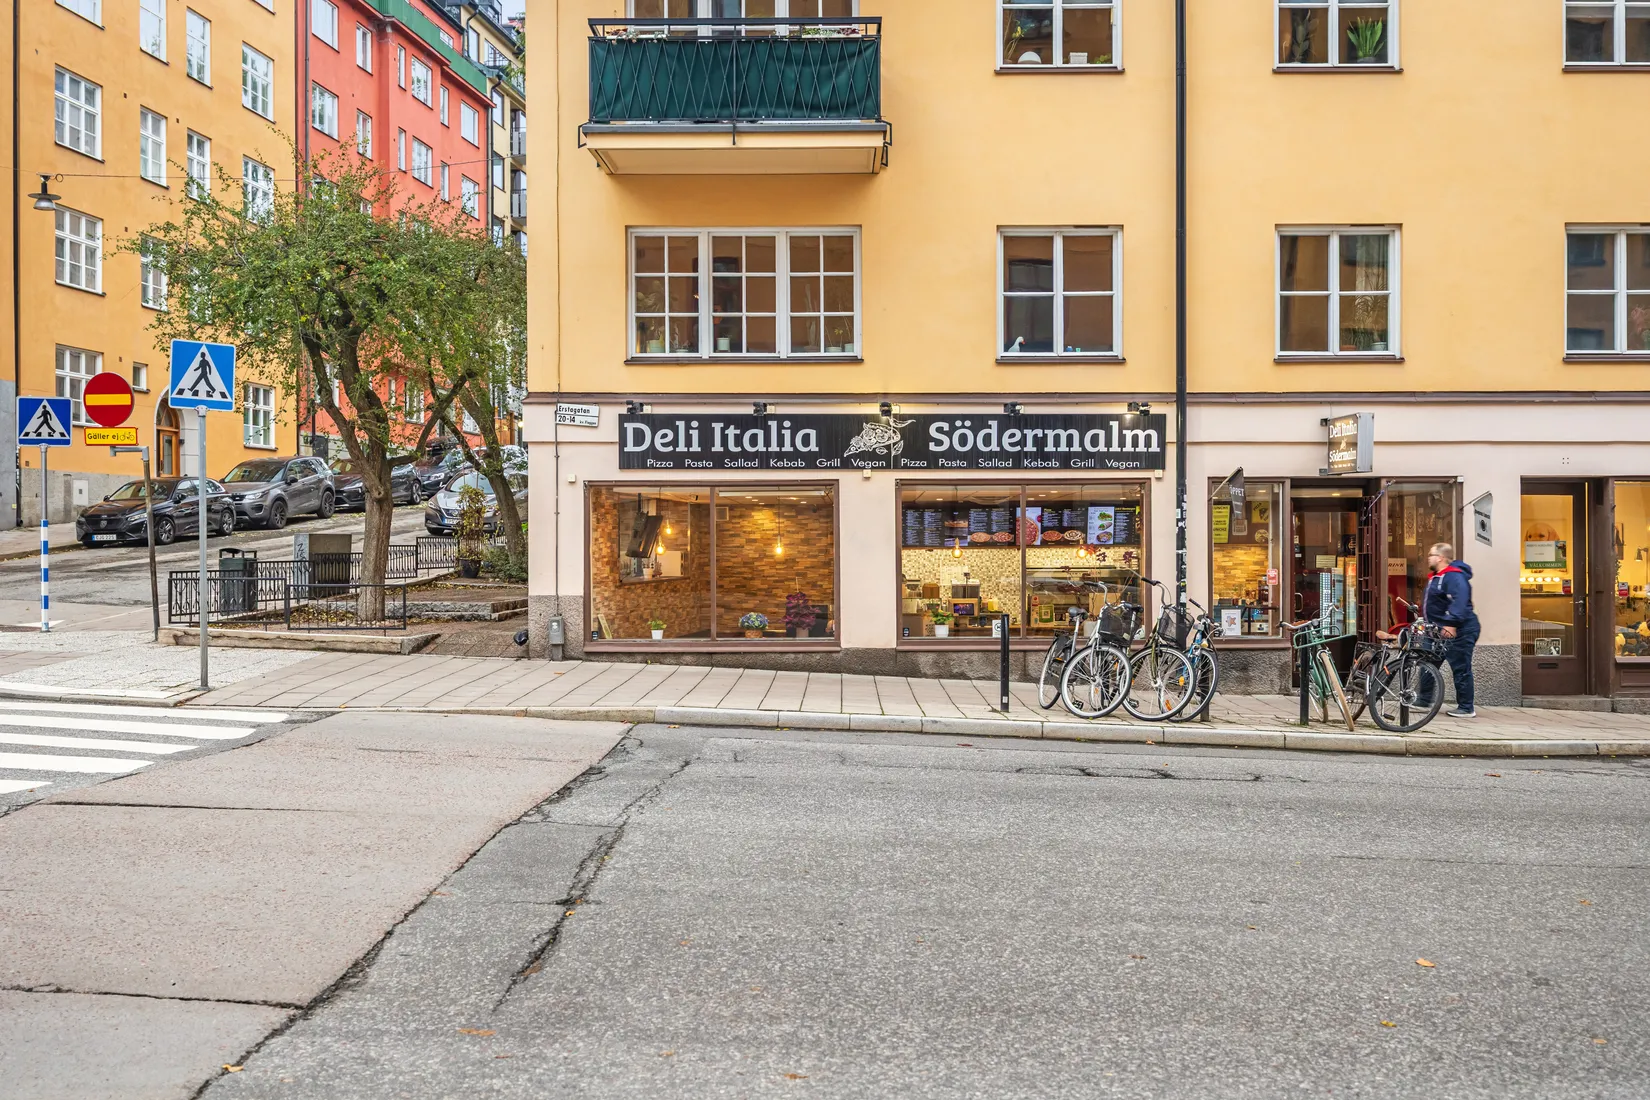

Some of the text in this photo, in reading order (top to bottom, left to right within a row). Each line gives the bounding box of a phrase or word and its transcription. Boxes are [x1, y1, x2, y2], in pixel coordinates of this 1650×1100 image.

[559, 405, 590, 414] Erstagatan
[87, 432, 118, 441] Gäller ej
[623, 420, 819, 453] Deli Italia
[928, 420, 1161, 453] Södermalm
[1329, 423, 1341, 438] Deli
[1329, 447, 1357, 463] Södermalm
[647, 458, 886, 469] Pizza Pasta Sallad Kebab Grill Vegan
[901, 458, 1140, 469] Pizza Pasta Sallad Kebab Grill Vegan
